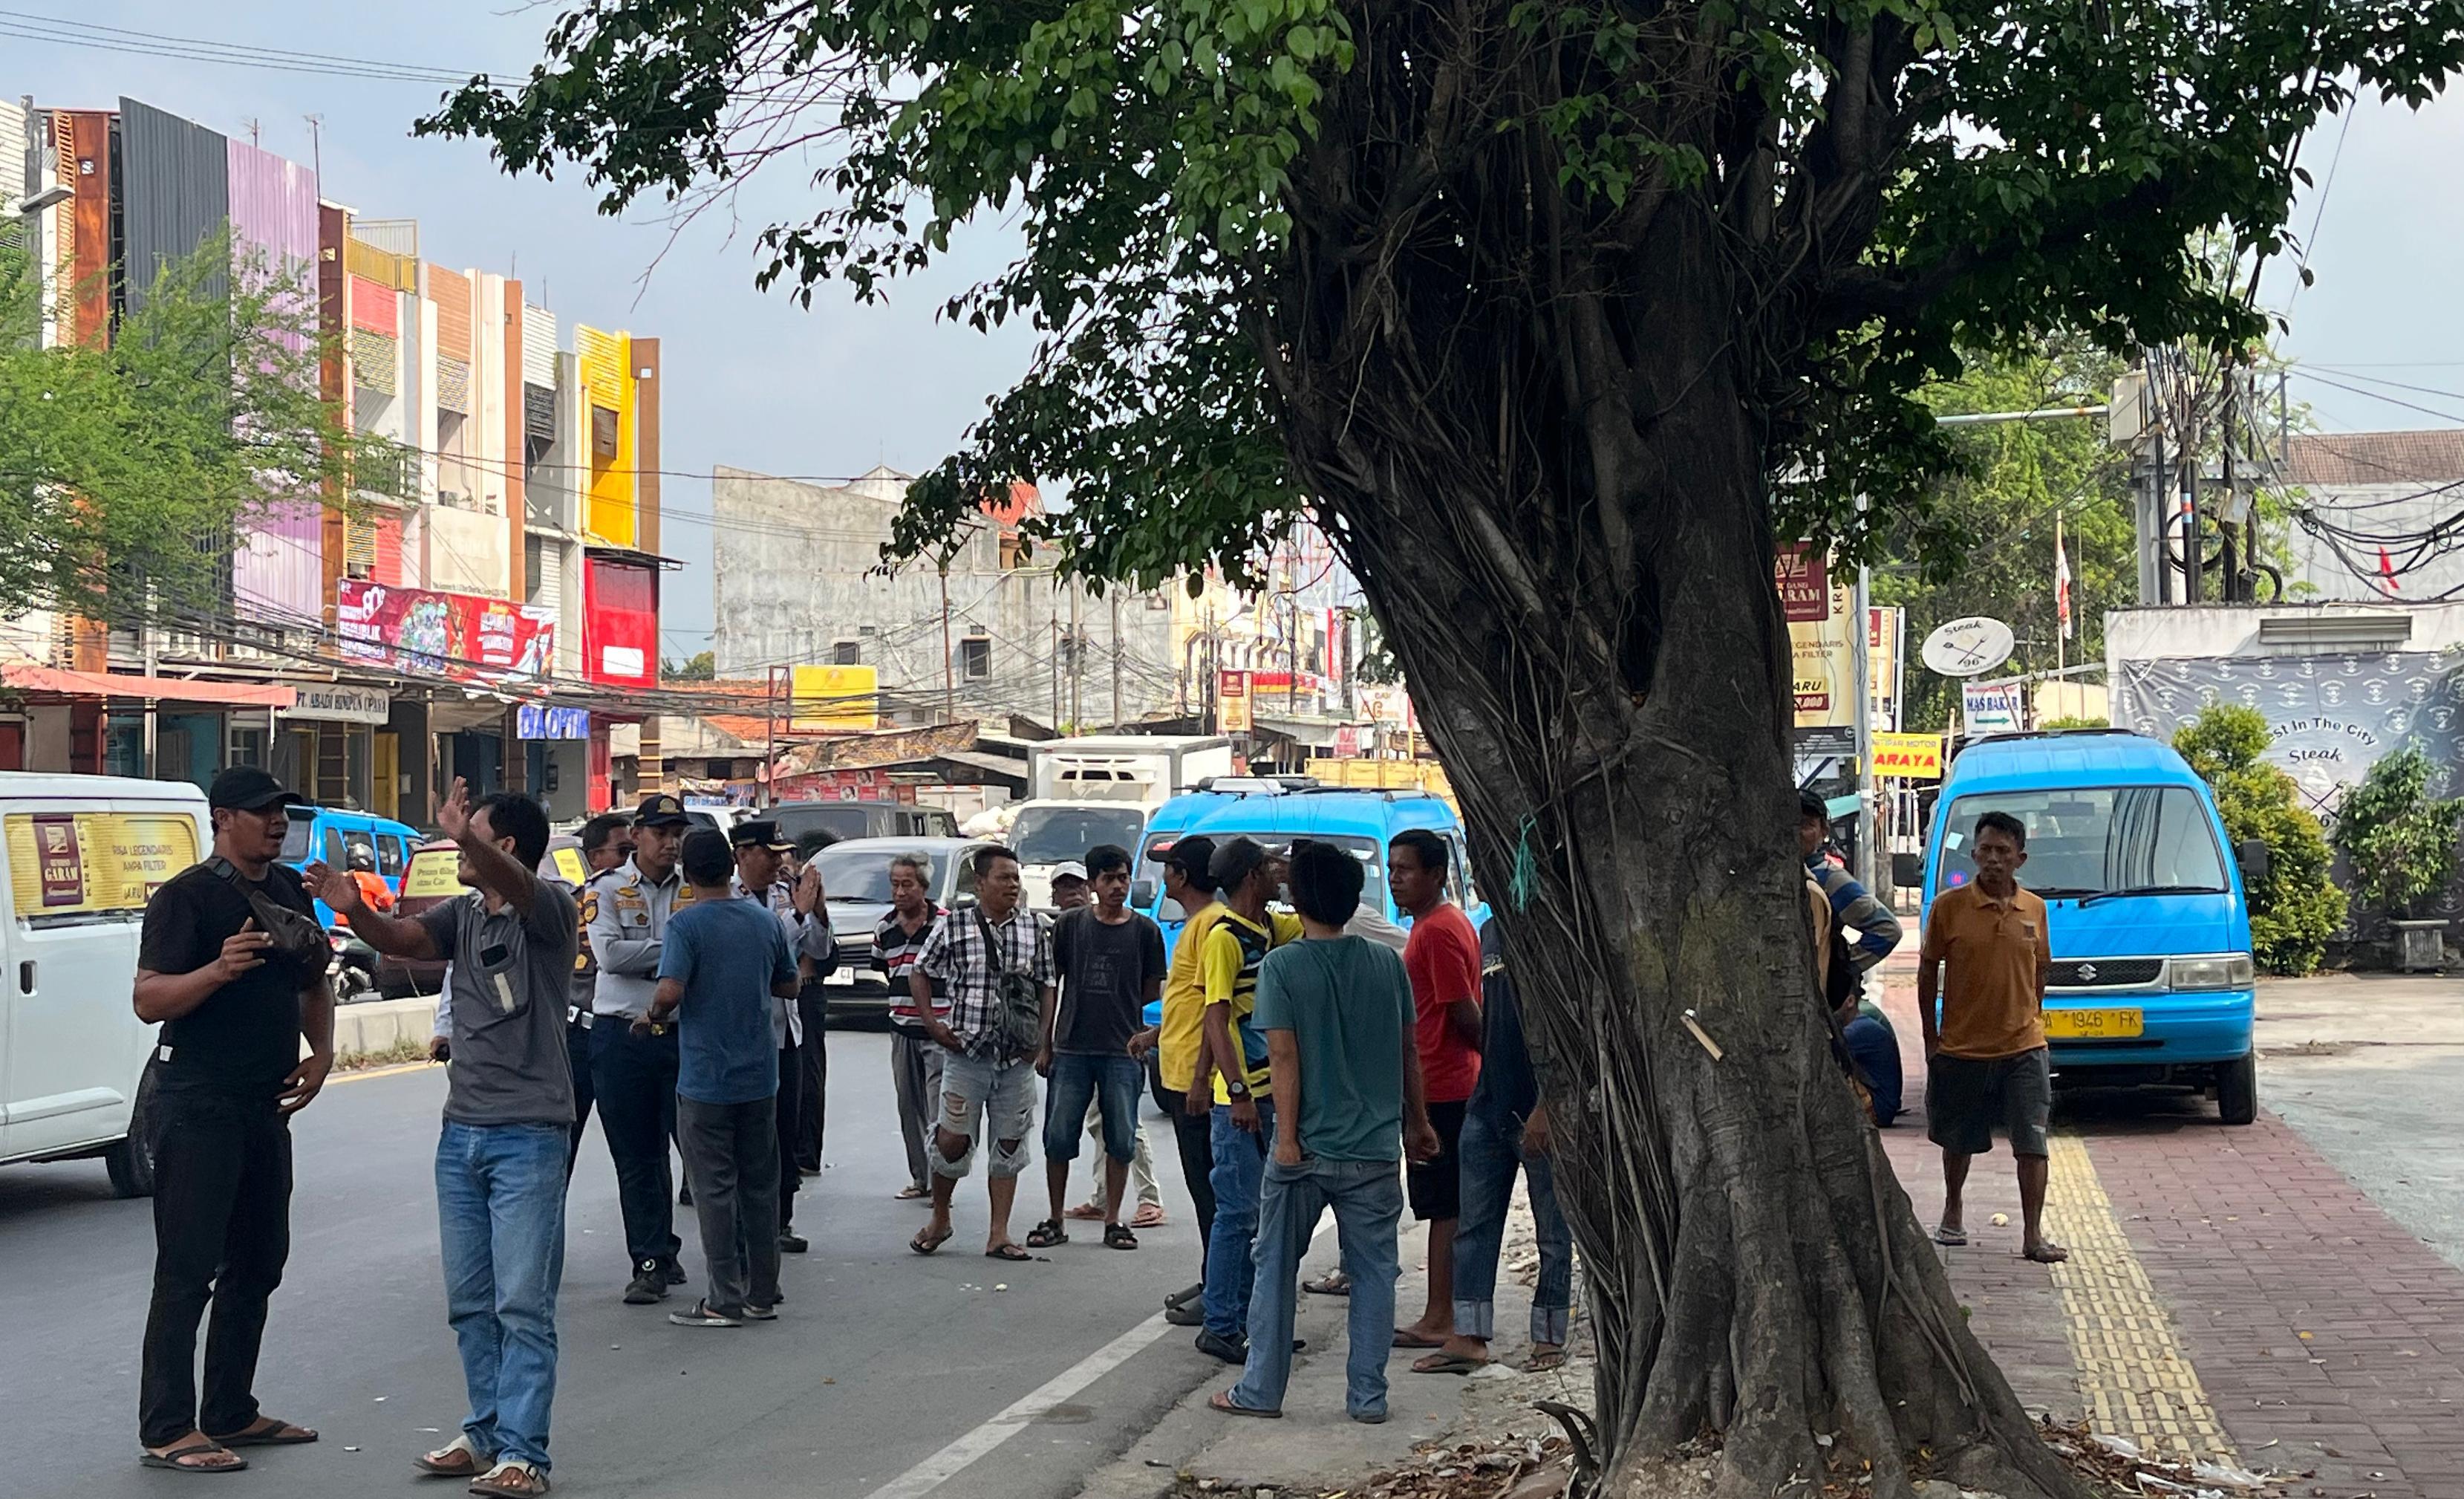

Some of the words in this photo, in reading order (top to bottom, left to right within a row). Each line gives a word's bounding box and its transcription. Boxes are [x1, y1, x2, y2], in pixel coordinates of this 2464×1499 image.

[1943, 620, 1984, 636] Steak
[1802, 649, 1833, 659] FILTER
[1793, 680, 1822, 692] ARU
[1966, 696, 1986, 712] MAS
[2291, 719, 2307, 731] In
[2312, 718, 2342, 730] The
[2347, 724, 2377, 746] City
[1874, 753, 1935, 767] ARAYA
[2289, 747, 2344, 764] Steak
[2072, 1011, 2103, 1029] 1946
[2119, 1010, 2139, 1028] FK
